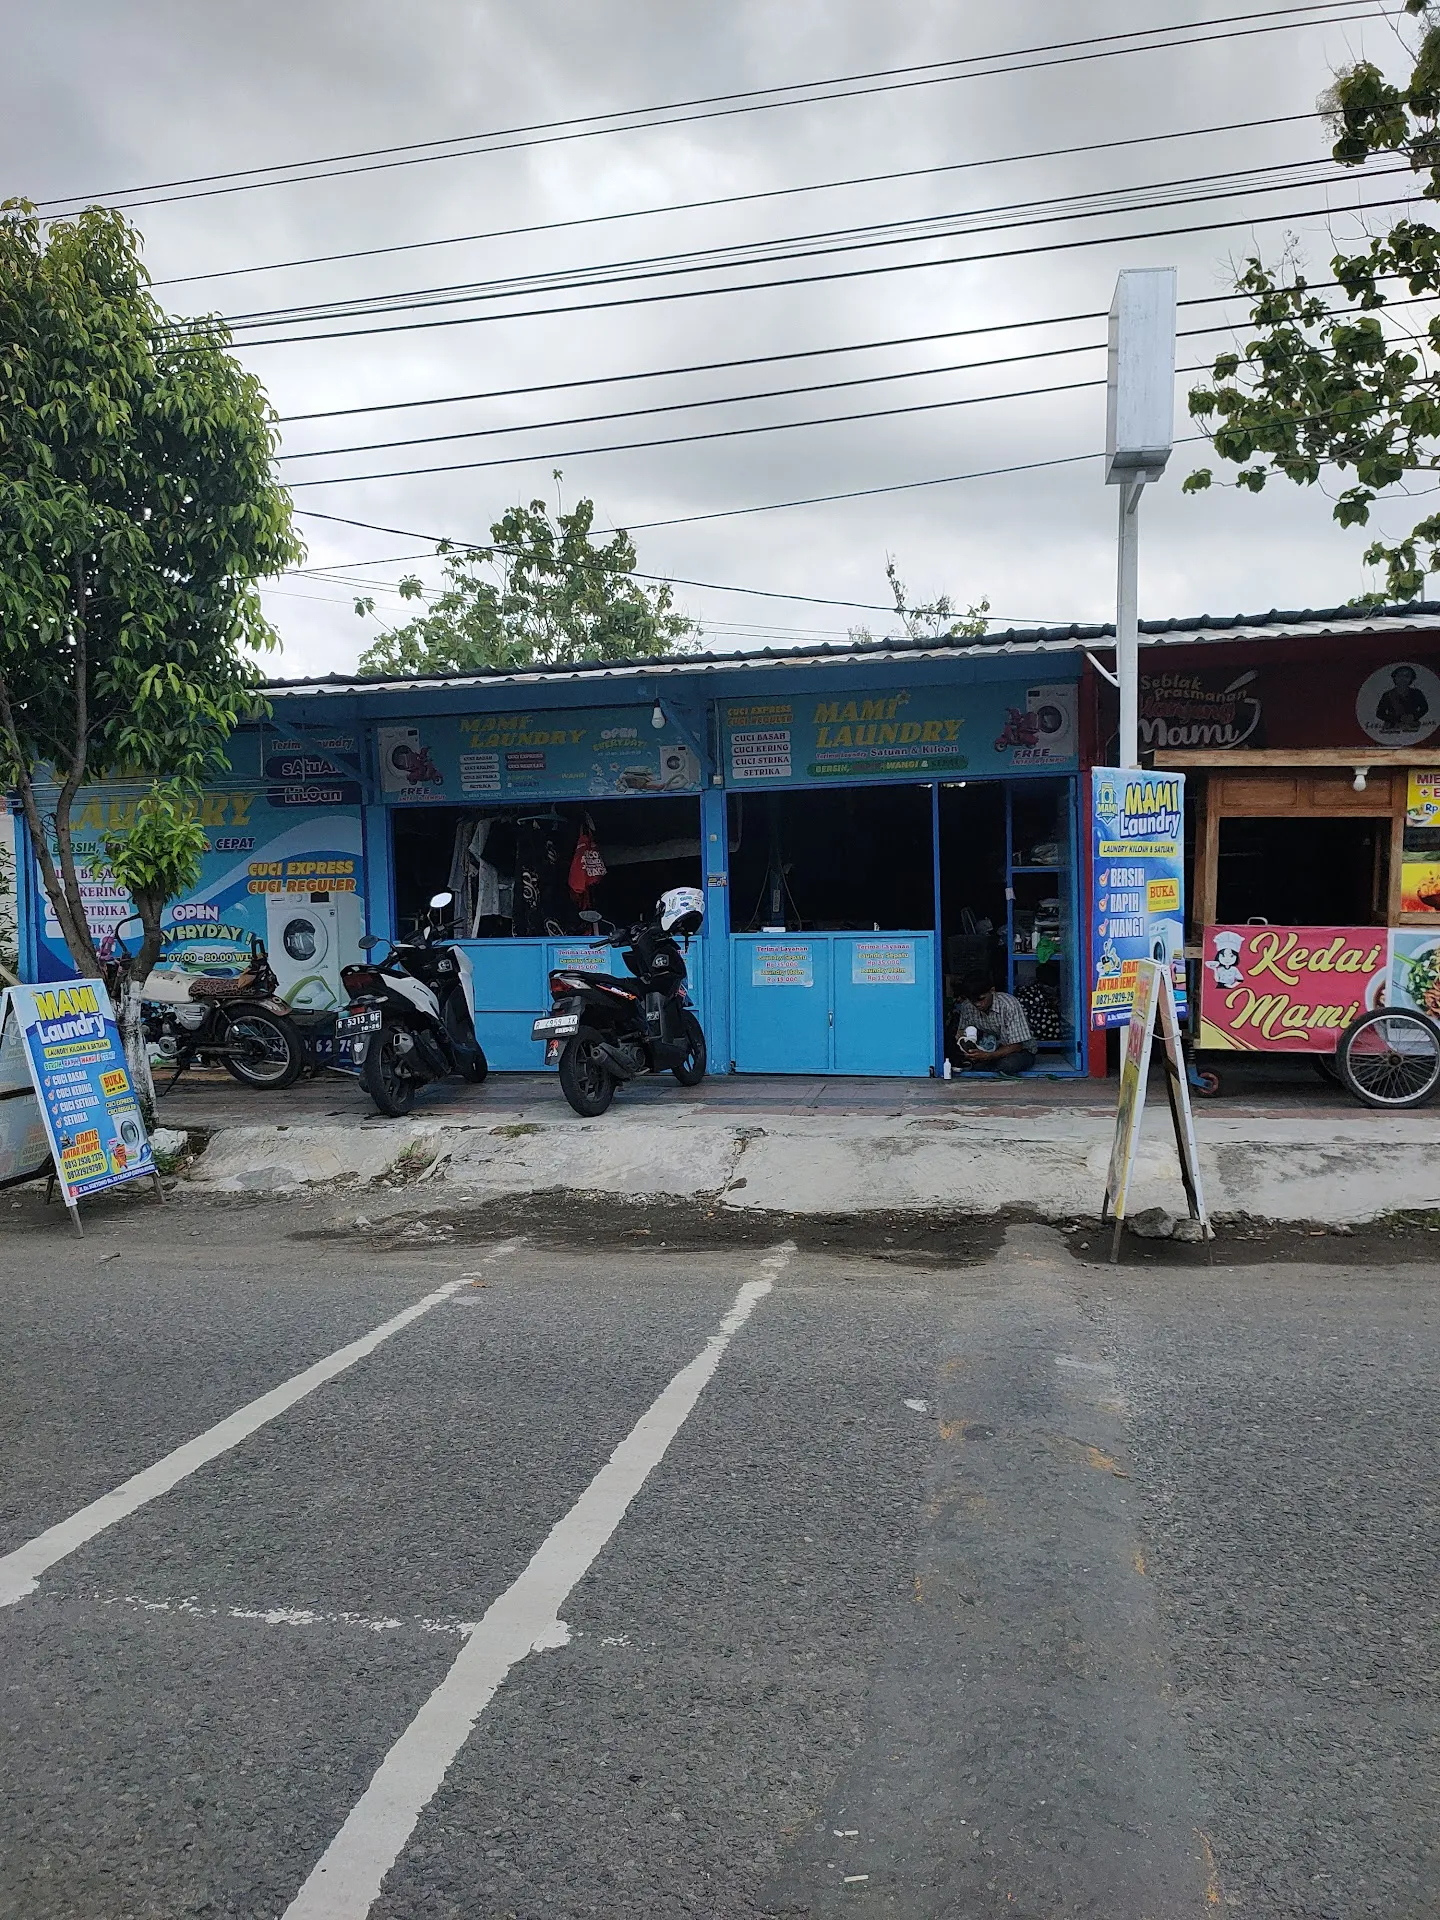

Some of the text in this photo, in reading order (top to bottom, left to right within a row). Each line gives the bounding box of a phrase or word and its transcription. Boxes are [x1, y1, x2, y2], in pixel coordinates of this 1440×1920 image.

[1139, 672, 1202, 691] Seblak
[813, 698, 898, 724] MAMI
[469, 729, 587, 748] LAUNDRY
[734, 732, 786, 743] CUCI BASAH
[815, 718, 965, 748] LAUNDRY
[733, 744, 789, 755] CUCI KERING
[870, 747, 908, 758] Satuan
[1013, 748, 1051, 758] FREE
[735, 756, 790, 767] CUCI STRIKA
[743, 767, 781, 777] SETRIKA
[400, 787, 431, 796] FREE
[1125, 780, 1179, 815] MAMI
[1120, 807, 1181, 838] Laundry
[215, 837, 256, 851] CEPAT
[248, 860, 354, 877] CUCI EXPRESS
[1110, 867, 1145, 888] BERSIH
[79, 886, 126, 898] KERING
[247, 878, 356, 894] CUCI REGULER
[1150, 885, 1175, 898] BUKA
[1110, 892, 1140, 913] RAPIH
[171, 903, 219, 922] OPEN
[1109, 917, 1144, 938] WANGI
[168, 953, 196, 963] 07.00
[204, 953, 232, 963] 20.00
[235, 952, 252, 962] WI
[1247, 930, 1383, 986] Kedai
[1122, 961, 1139, 974] GRAT
[1098, 976, 1137, 991] ANTAR JEMP
[35, 985, 99, 1021] MAMI
[1225, 987, 1360, 1041] Mami
[35, 1012, 105, 1045] Laundry
[337, 1021, 343, 1029] R
[347, 1016, 365, 1026] 5313
[52, 1070, 88, 1086] CUCI BASAH
[103, 1073, 124, 1088] BUKA
[56, 1086, 72, 1099] CUCI
[59, 1095, 100, 1113] CUCI SETRIKA
[63, 1111, 89, 1126] SETRIKA
[75, 1129, 98, 1145] GRATIS
